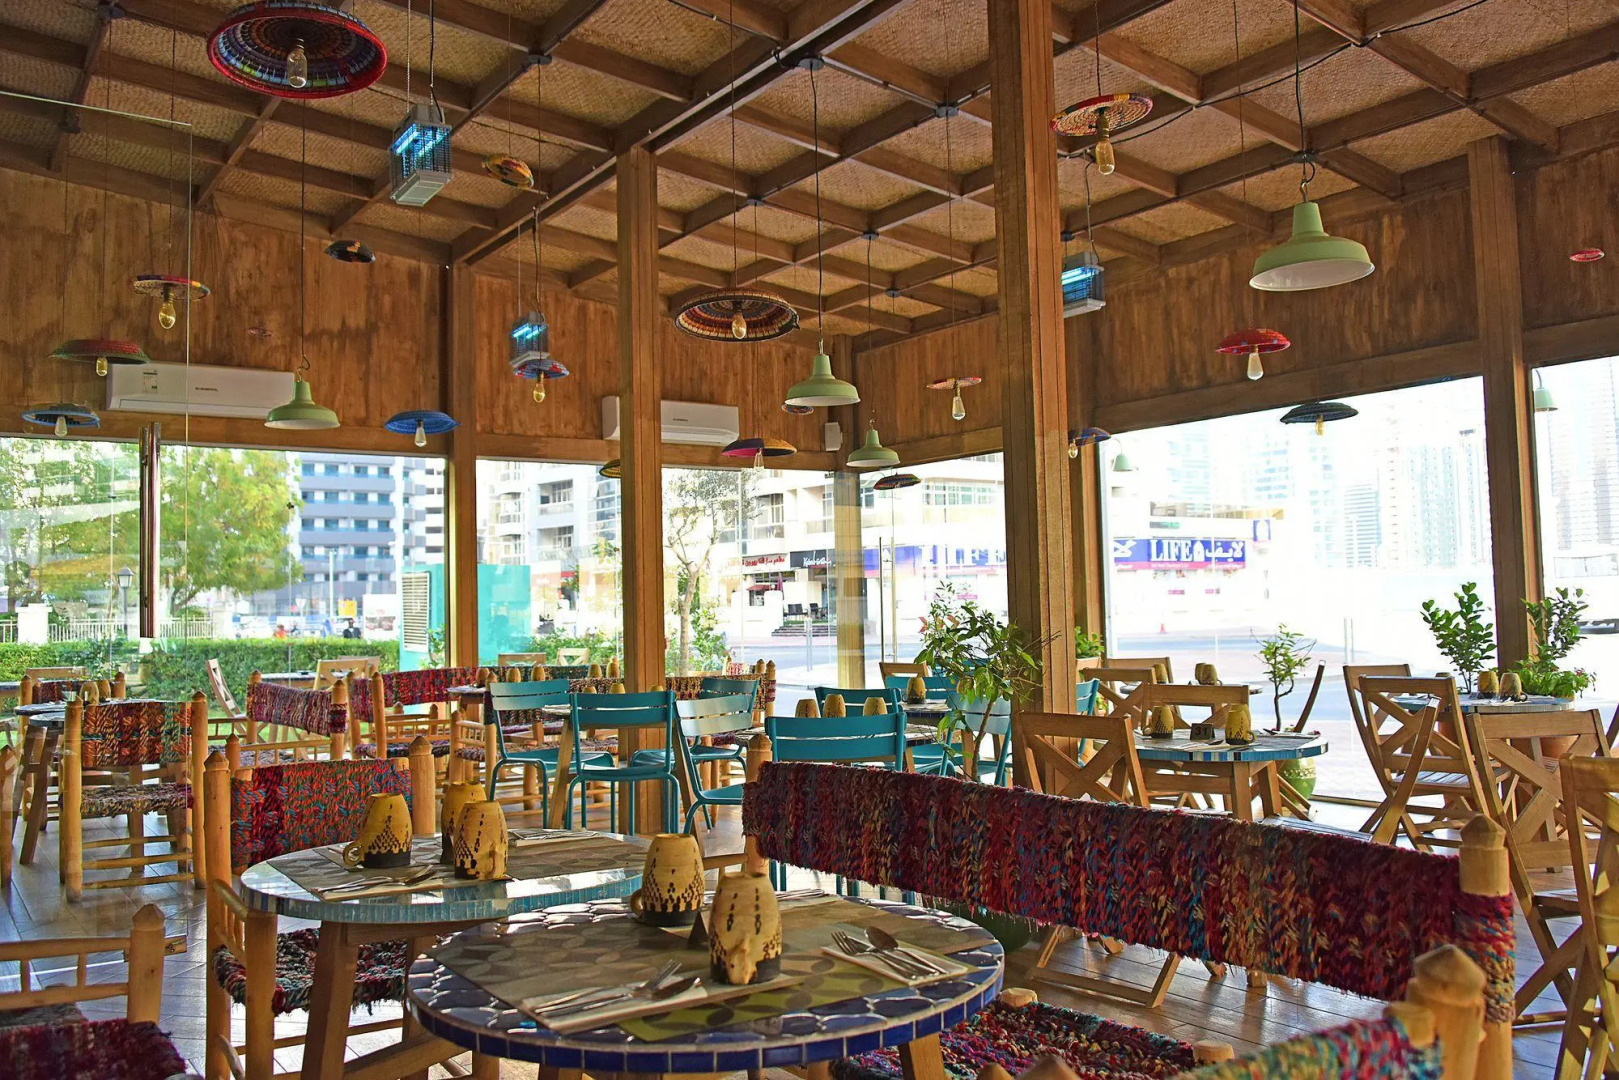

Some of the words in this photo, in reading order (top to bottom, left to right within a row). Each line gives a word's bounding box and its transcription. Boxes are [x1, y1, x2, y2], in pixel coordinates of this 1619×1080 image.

[1150, 539, 1193, 562] LIFE
[1205, 541, 1244, 562] لايف
[1195, 726, 1208, 736] 31
